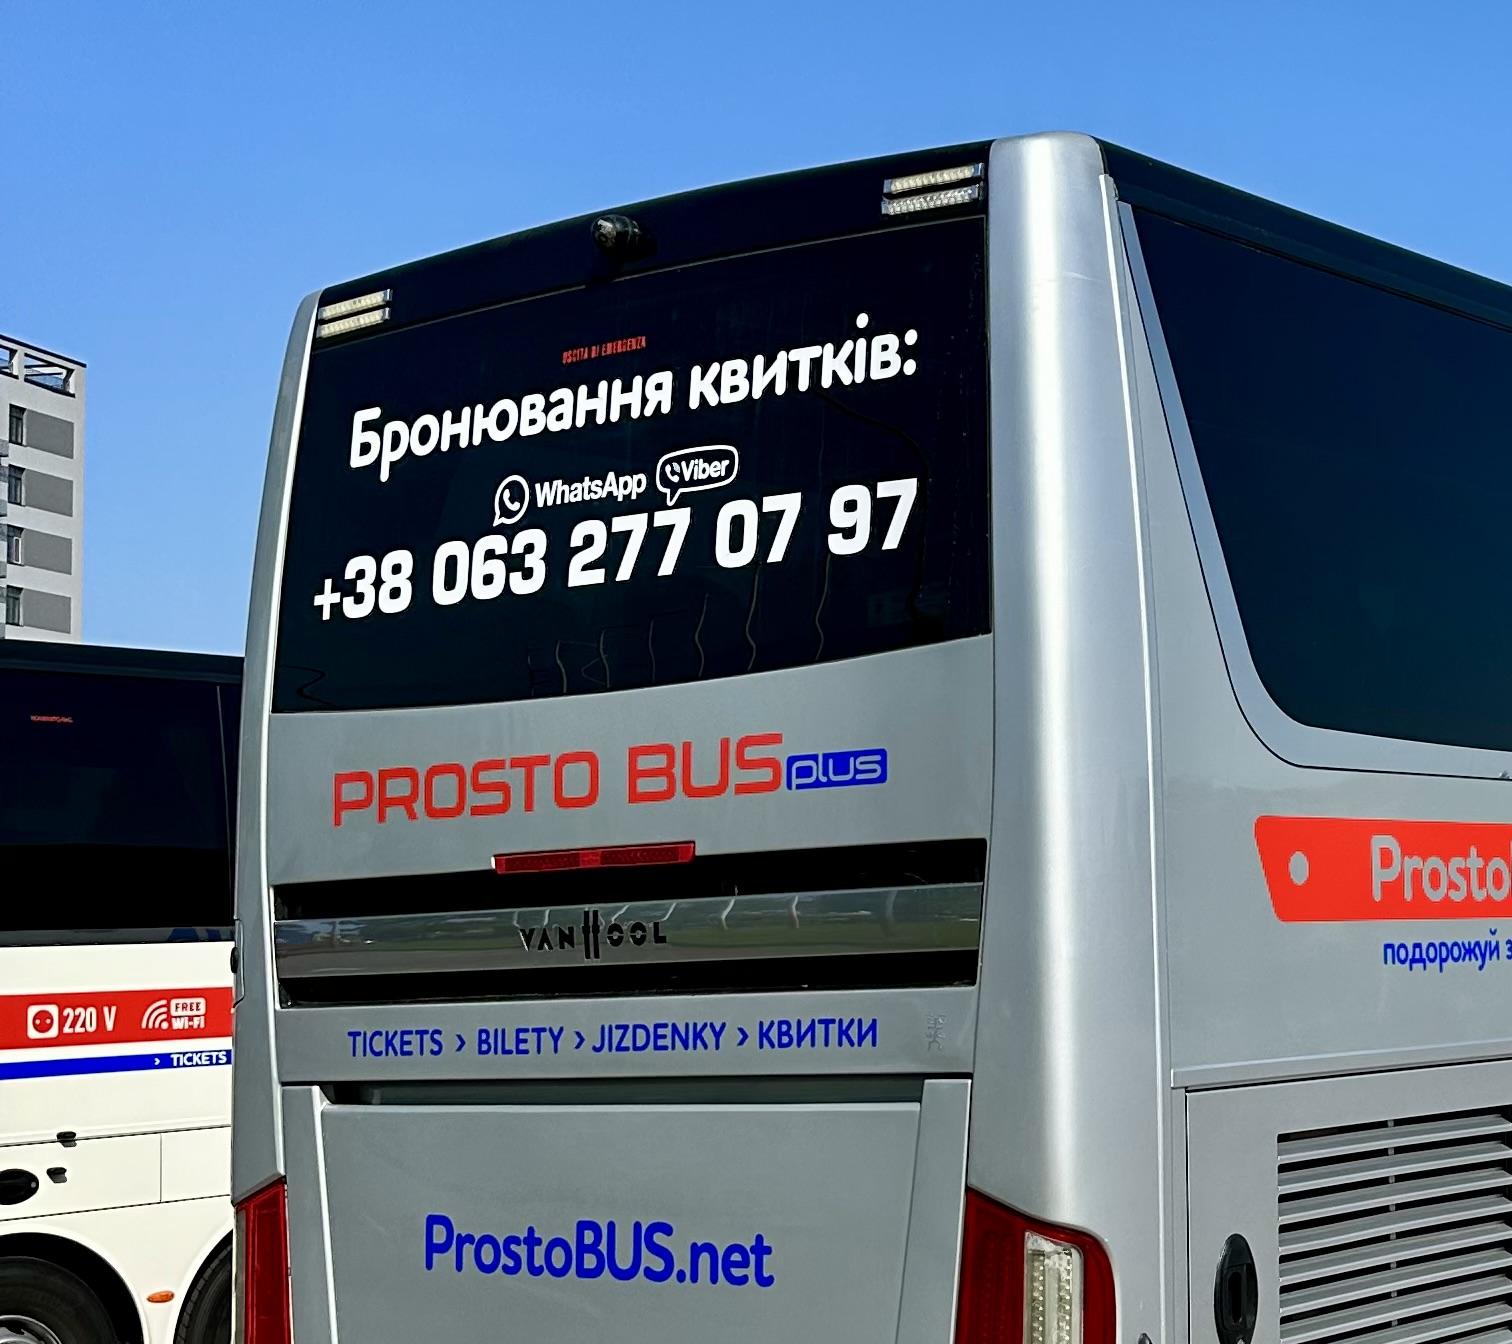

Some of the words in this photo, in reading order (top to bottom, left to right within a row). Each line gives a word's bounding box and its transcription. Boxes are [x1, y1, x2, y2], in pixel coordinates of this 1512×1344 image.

[349, 370, 673, 482] Бронювання
[688, 312, 919, 409] квитків:
[534, 471, 648, 508] WhatsApp
[681, 459, 731, 481] Viber
[313, 549, 414, 621] +38
[432, 528, 548, 606] 063
[567, 506, 692, 587] 277
[715, 492, 802, 569] 07
[827, 477, 919, 555] 97
[333, 750, 600, 827] PROSTO
[627, 732, 784, 805] BUS
[1383, 928, 1500, 973] подорожуй
[62, 1006, 97, 1034] 220
[102, 1006, 117, 1031] V
[174, 1001, 202, 1012] FREE
[347, 1028, 444, 1057] TICKETS
[477, 1026, 564, 1056] BILETY
[591, 1022, 727, 1053] JIZDENKY
[757, 1017, 879, 1049] КВИТКИ
[169, 1050, 227, 1067] TICKETS
[424, 1213, 775, 1289] ProstoBUS.net
